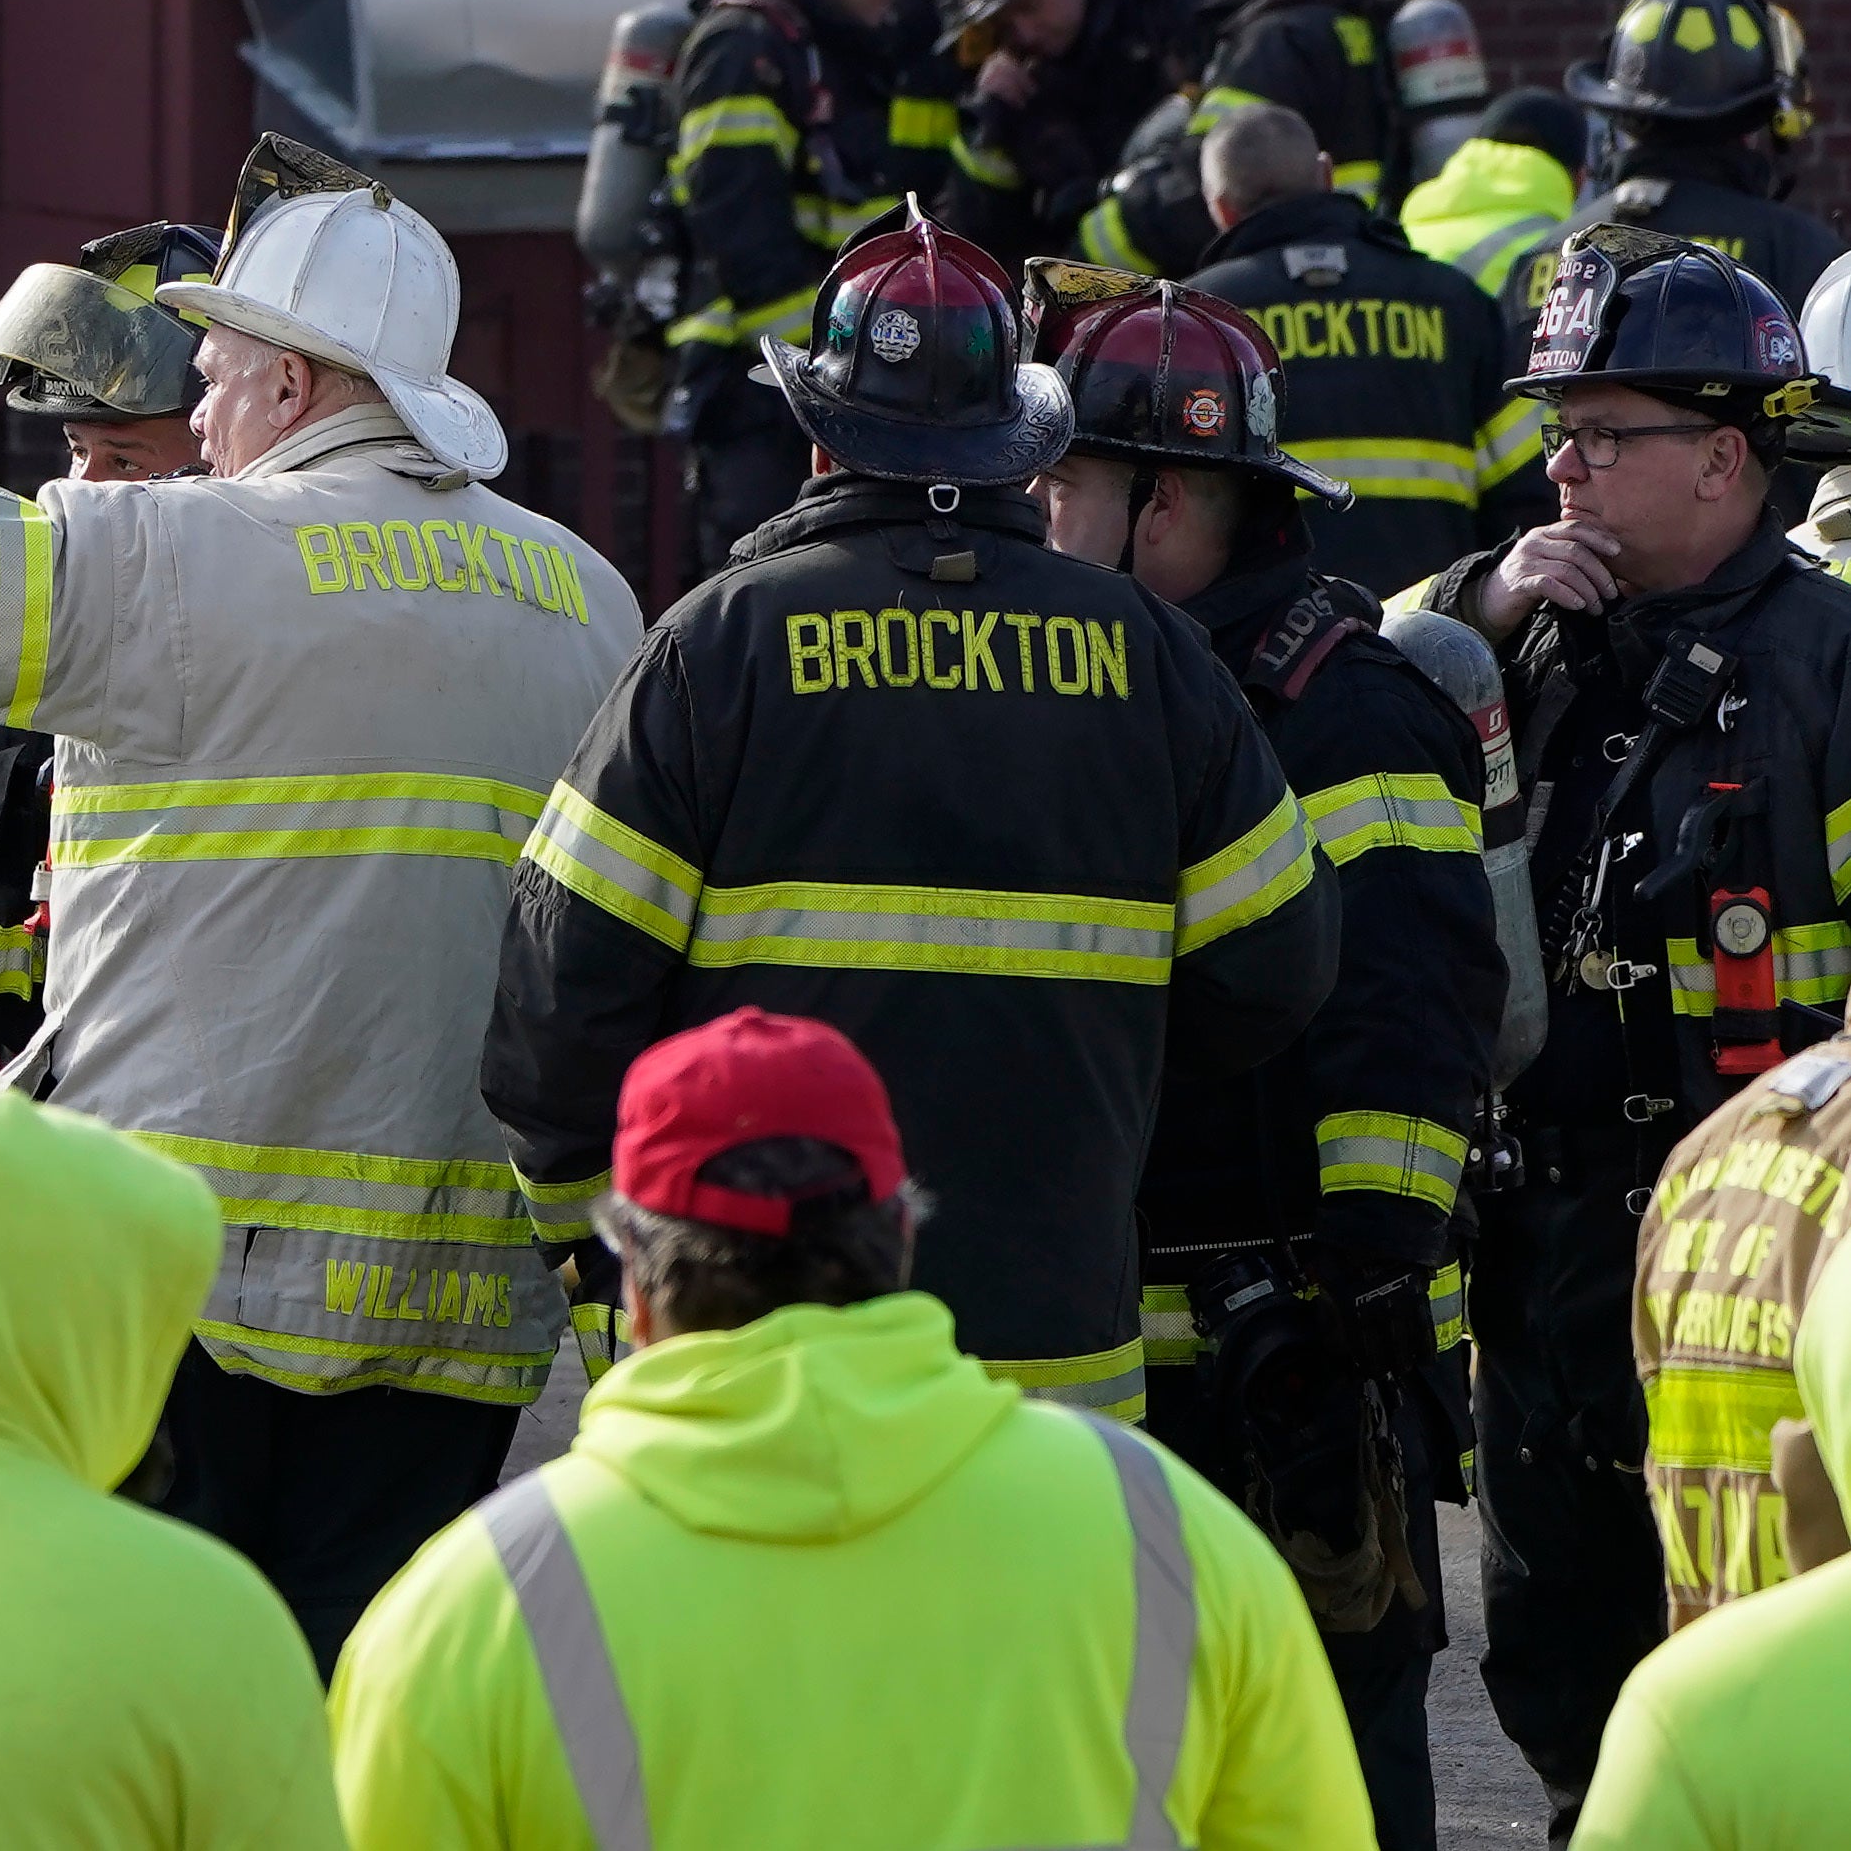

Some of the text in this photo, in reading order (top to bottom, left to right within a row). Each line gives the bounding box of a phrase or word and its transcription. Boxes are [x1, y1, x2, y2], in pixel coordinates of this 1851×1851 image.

[295, 519, 590, 626] BROCKTON
[785, 607, 1131, 700] BROCKTON
[325, 1258, 513, 1329] WILLIAMS
